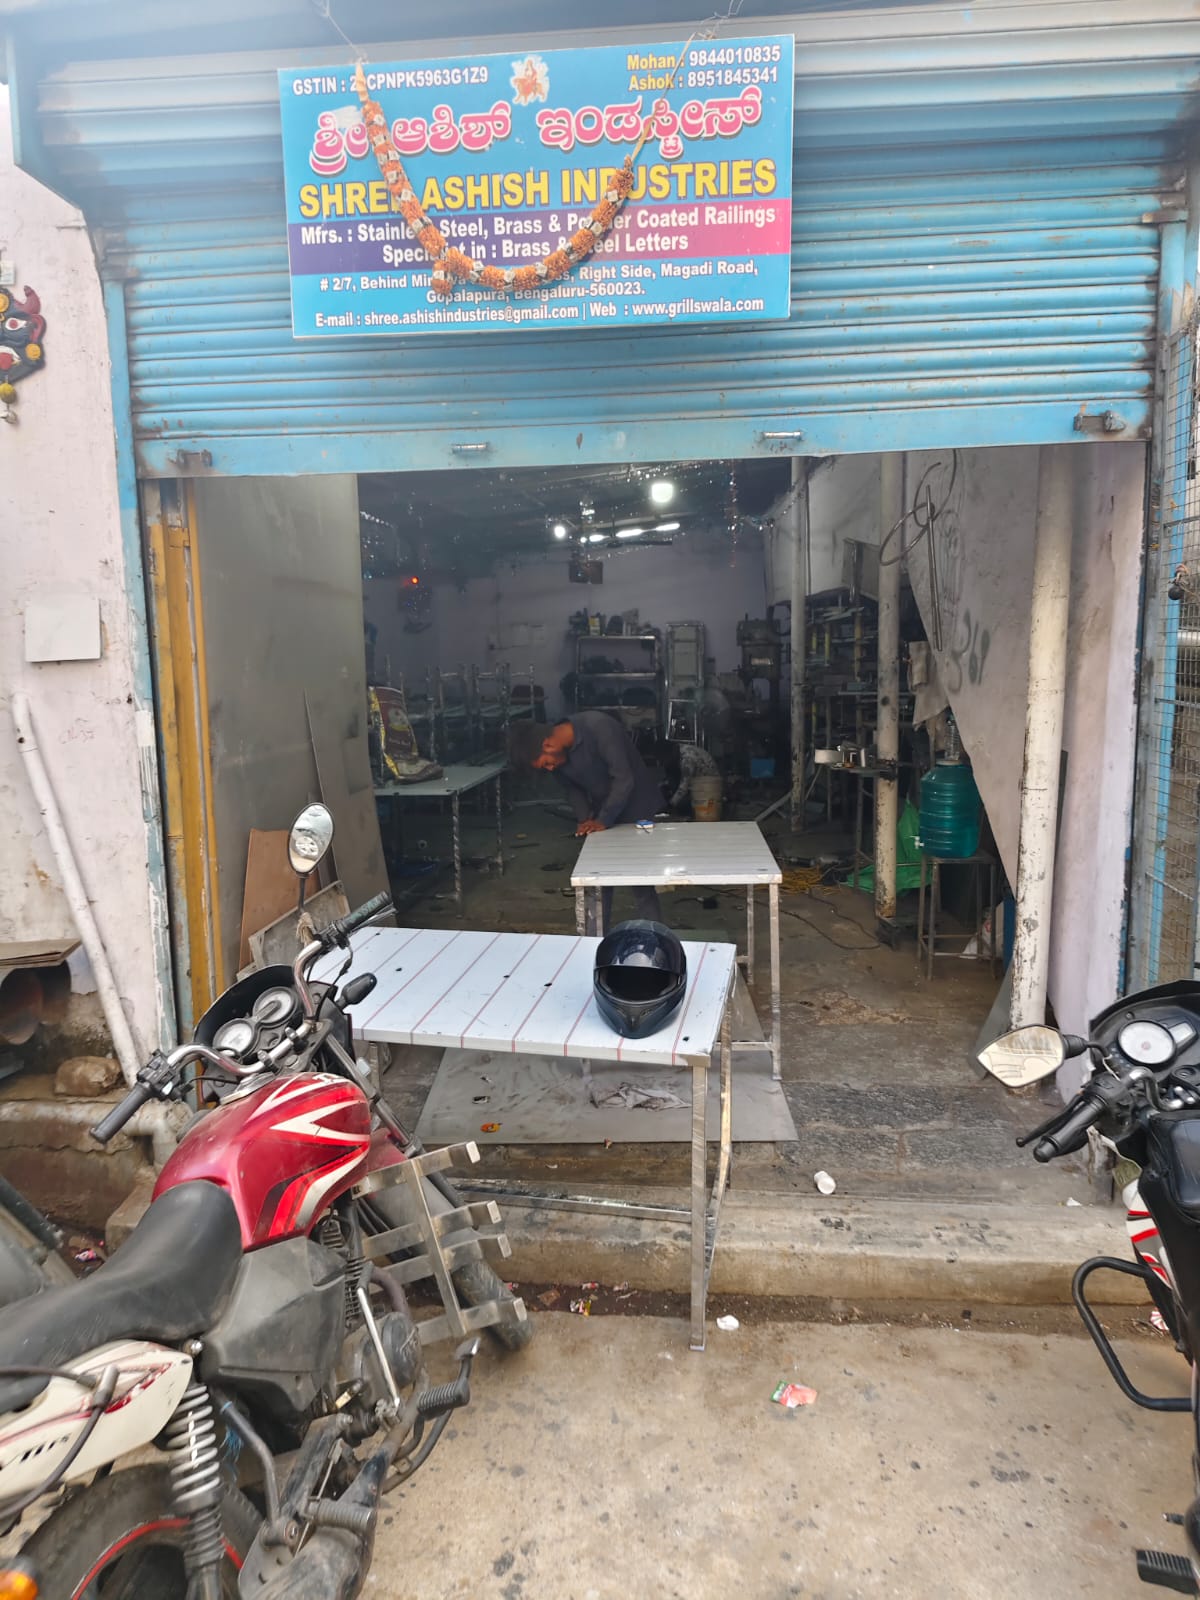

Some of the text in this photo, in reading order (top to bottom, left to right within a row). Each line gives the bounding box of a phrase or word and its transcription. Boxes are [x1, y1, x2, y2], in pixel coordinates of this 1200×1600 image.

[627, 54, 675, 70] Mohan
[689, 45, 781, 67] 9844010835
[293, 77, 337, 95] GSTIN
[350, 66, 488, 92] 2CPNPK5963G1Z9
[628, 73, 674, 91] Ashok
[688, 66, 778, 88] 8951845341
[391, 101, 511, 155] ಆಶಿಶ್
[423, 170, 549, 212] ASHISH
[302, 226, 342, 245] Mfrs.
[357, 222, 417, 242] Stainle
[439, 218, 488, 240] Steel,
[494, 216, 542, 235] Brass
[549, 214, 561, 232] &
[567, 212, 631, 231] Poer
[637, 208, 698, 228] Coated
[705, 205, 776, 229] Railings
[471, 241, 487, 259] in
[502, 239, 550, 257] Brass
[587, 233, 619, 253] eel
[626, 233, 688, 251] Letters
[320, 278, 328, 291] #
[333, 277, 356, 292] 2/7,
[361, 274, 407, 289] Behind
[580, 265, 616, 282] Right
[621, 264, 656, 279] Side,
[661, 262, 713, 278] Magadi
[717, 260, 758, 275] Road,
[315, 312, 353, 328] E-mail
[365, 306, 578, 325] shree.ashishindustries@gmail.com
[590, 302, 616, 317] Web
[632, 297, 764, 317] www.grillswala.com
